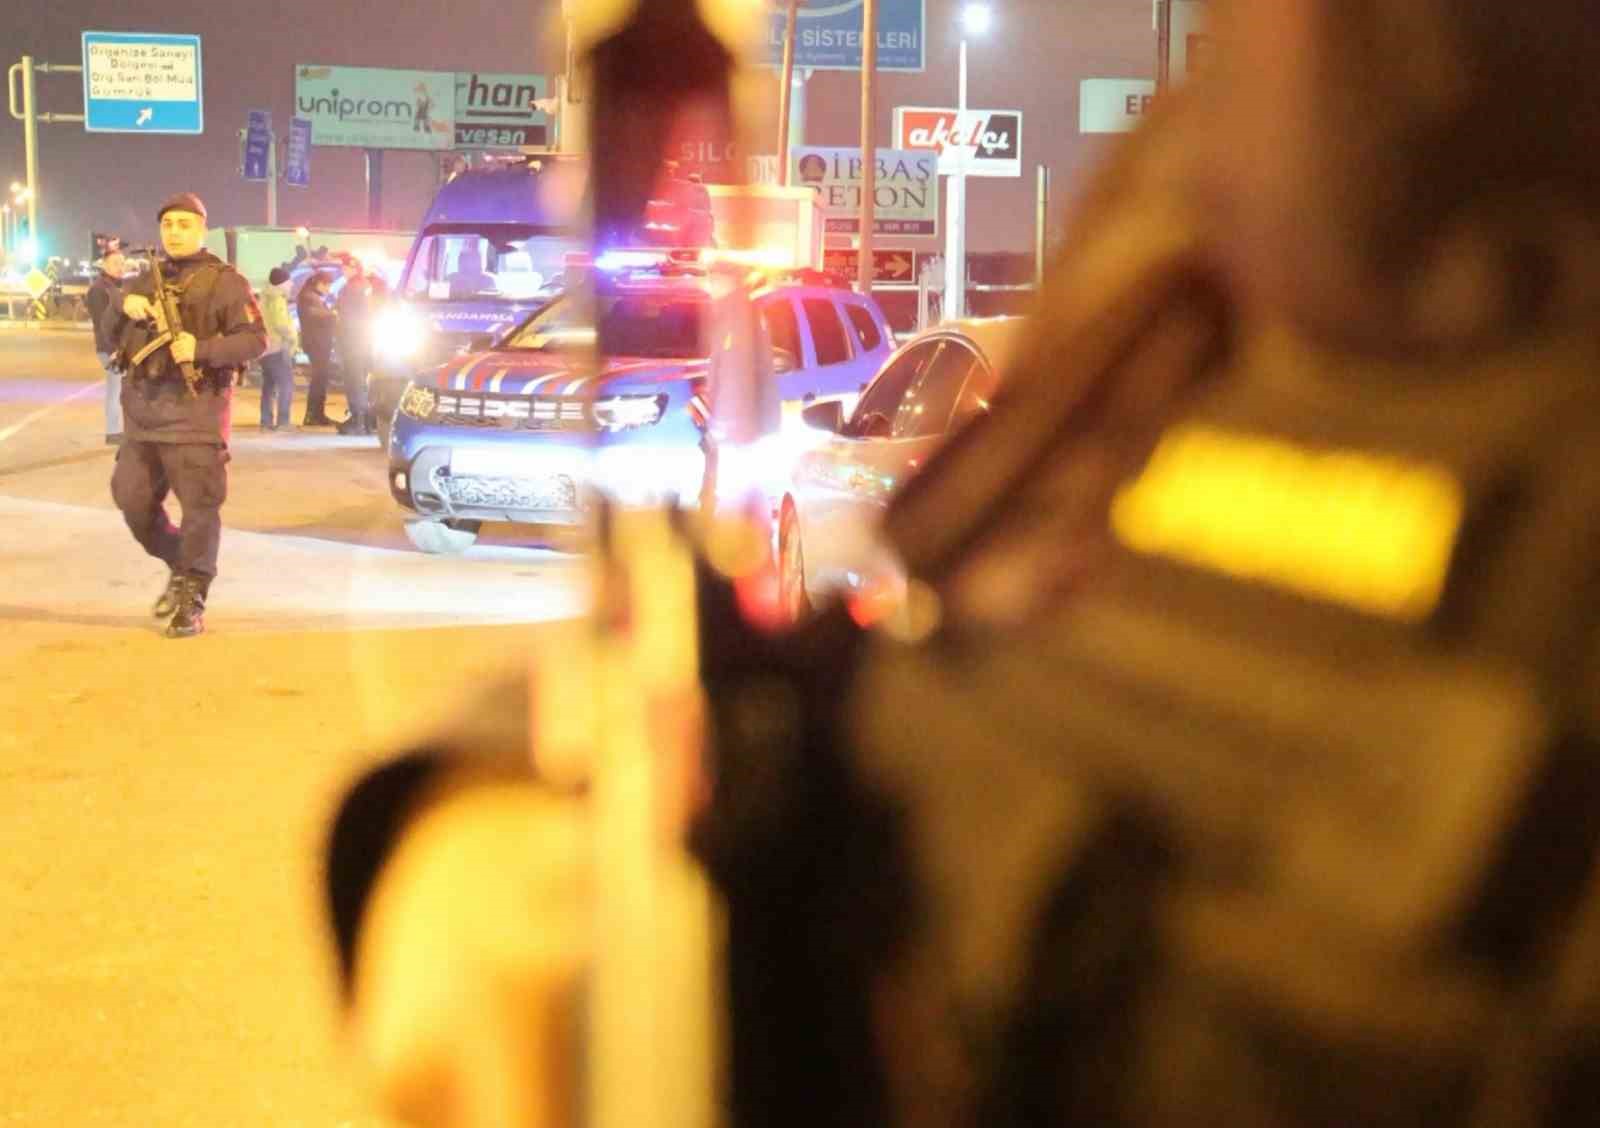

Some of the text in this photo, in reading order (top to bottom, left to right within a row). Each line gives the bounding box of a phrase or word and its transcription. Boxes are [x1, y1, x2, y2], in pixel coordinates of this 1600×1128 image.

[802, 25, 918, 49] SİSTELERİ
[298, 87, 413, 121] uniprom
[811, 184, 928, 209] ETON
